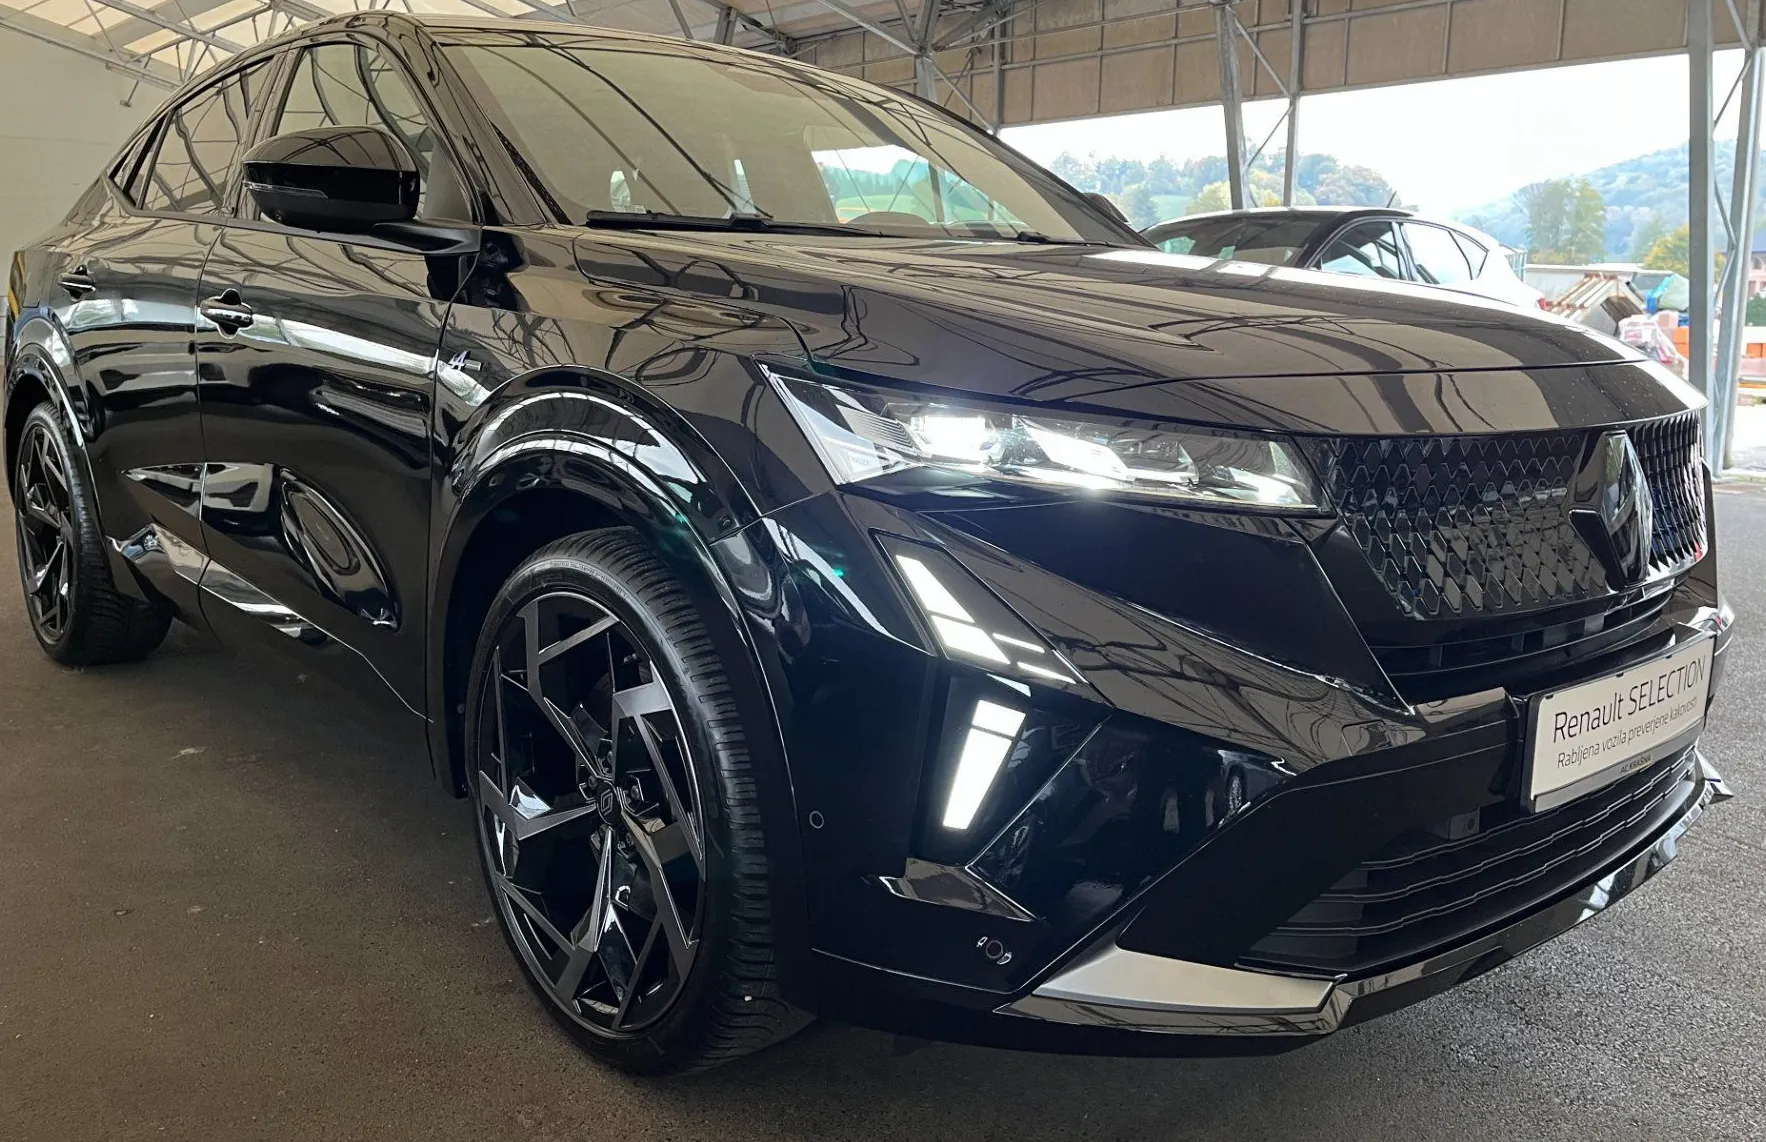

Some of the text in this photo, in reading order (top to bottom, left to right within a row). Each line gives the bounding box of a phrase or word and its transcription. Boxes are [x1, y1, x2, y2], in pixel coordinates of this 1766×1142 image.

[1552, 655, 1706, 744] Renault SELECTION
[1557, 743, 1600, 768] Rabljena
[1602, 729, 1627, 751] vozila
